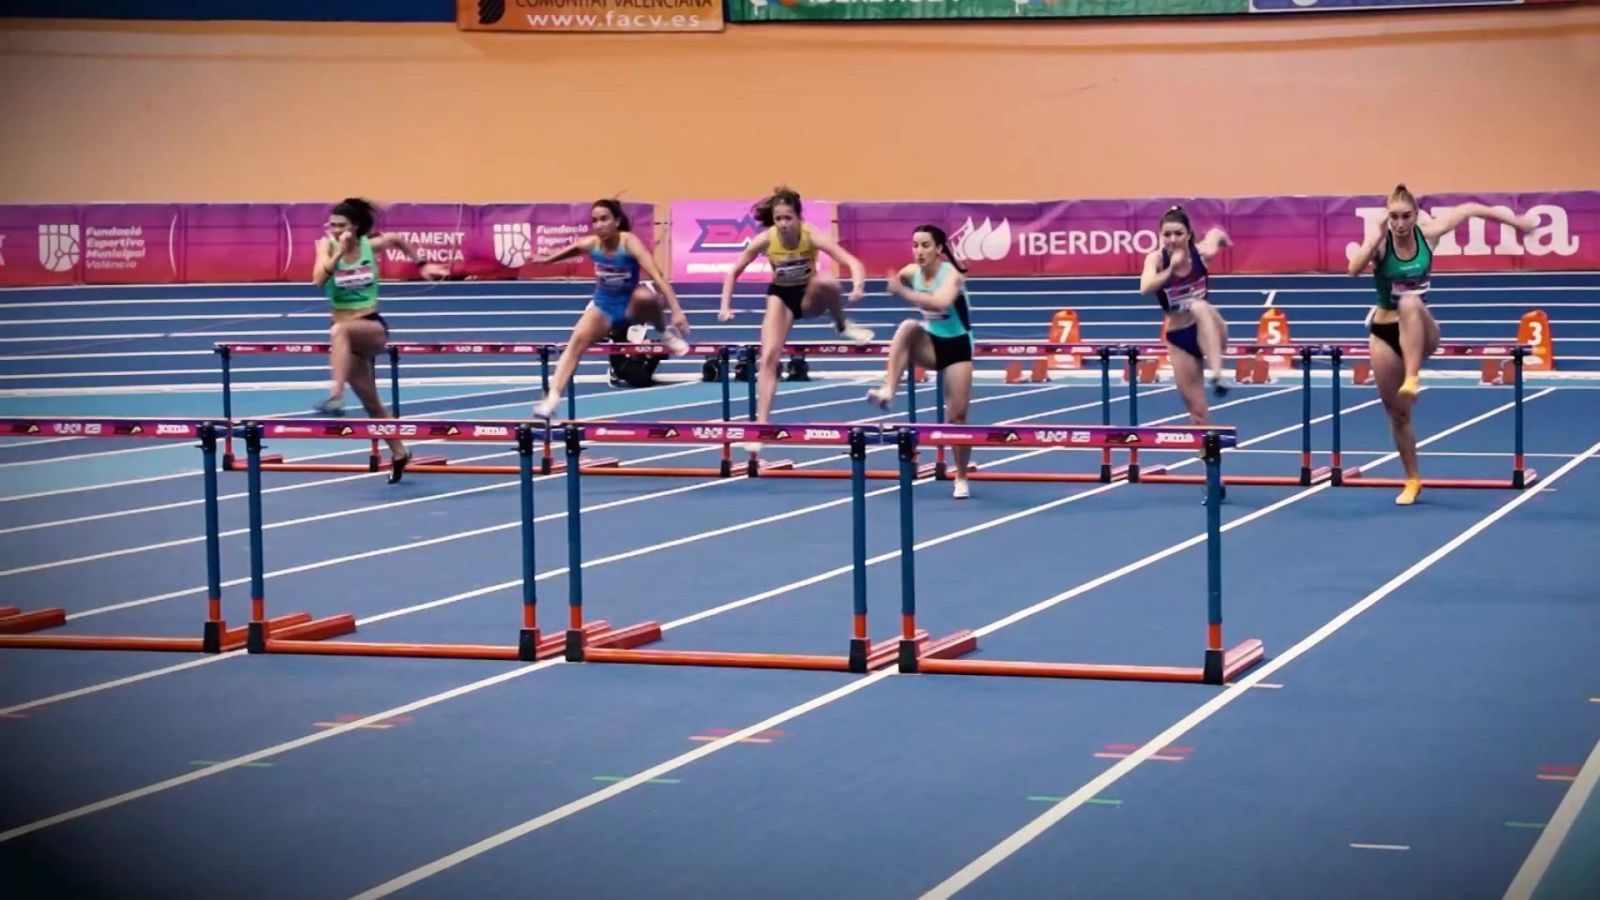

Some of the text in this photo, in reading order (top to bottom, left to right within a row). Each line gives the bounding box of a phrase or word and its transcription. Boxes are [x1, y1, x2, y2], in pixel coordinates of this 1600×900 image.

[527, 10, 701, 28] www.facv.es
[86, 226, 143, 238] Fundació
[536, 224, 589, 236] Fundació
[86, 238, 146, 250] Esportiva
[1019, 230, 1160, 257] IBERDRO
[86, 248, 147, 261] Municipal
[1057, 319, 1075, 344] 7
[1266, 321, 1282, 345] 5
[1527, 321, 1543, 346] 3
